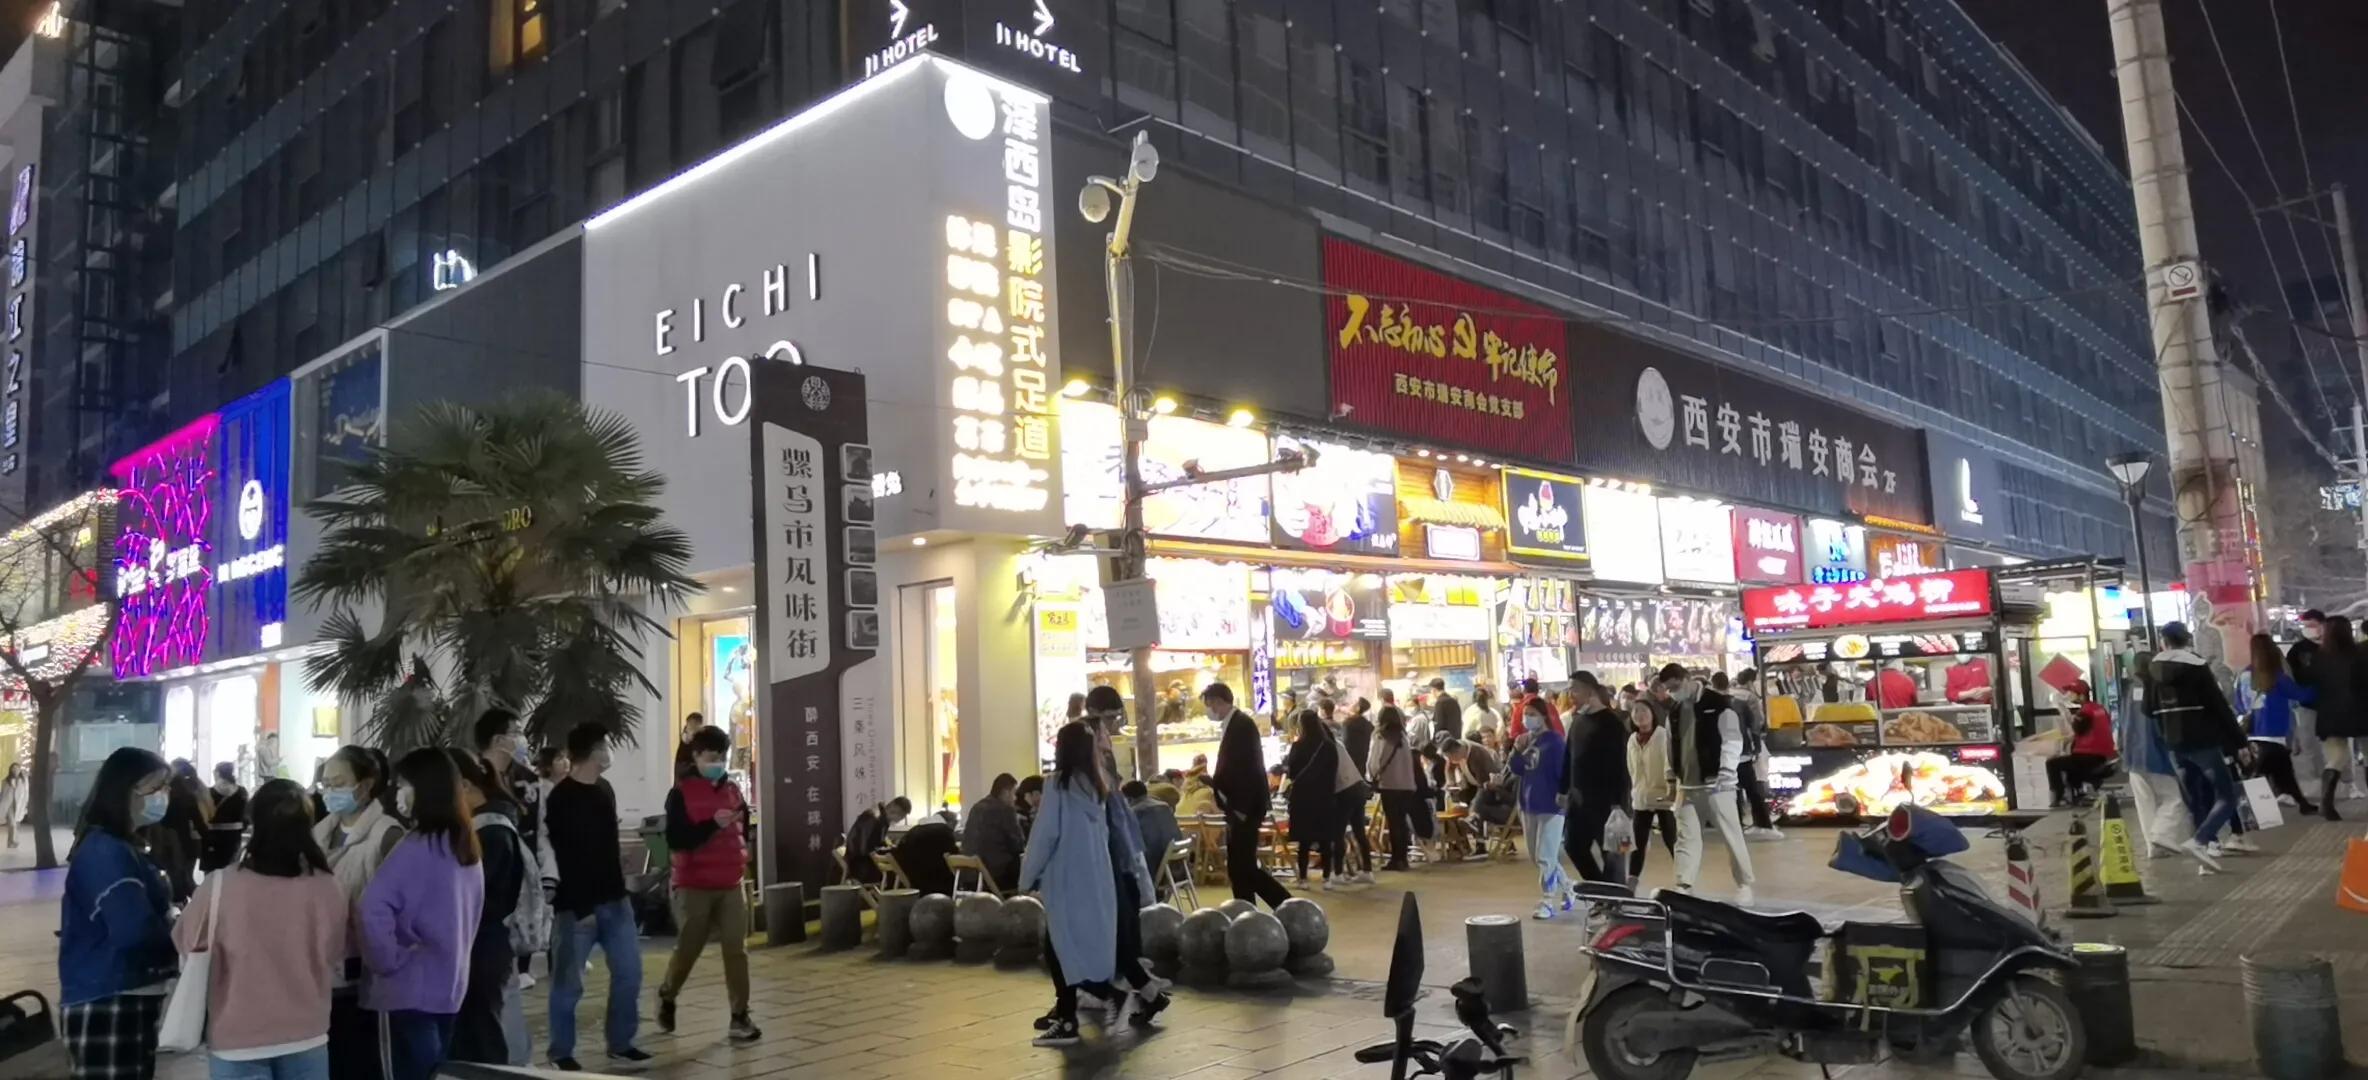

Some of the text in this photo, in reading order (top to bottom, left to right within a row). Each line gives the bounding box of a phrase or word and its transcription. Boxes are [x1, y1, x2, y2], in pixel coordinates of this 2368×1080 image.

[882, 23, 939, 68] HOTEL
[1015, 30, 1081, 73] HOTEL
[656, 252, 819, 356] EICHI
[1002, 101, 1050, 459] 泽西岛影院式足道
[676, 340, 802, 437] TO
[1339, 294, 1558, 407] 不忘初心 牢记使命
[1394, 373, 1525, 420] 西安市瑞安商会党支部
[1680, 394, 1879, 490] 西安市瑞安商会
[782, 447, 818, 658] 骡马市风味街
